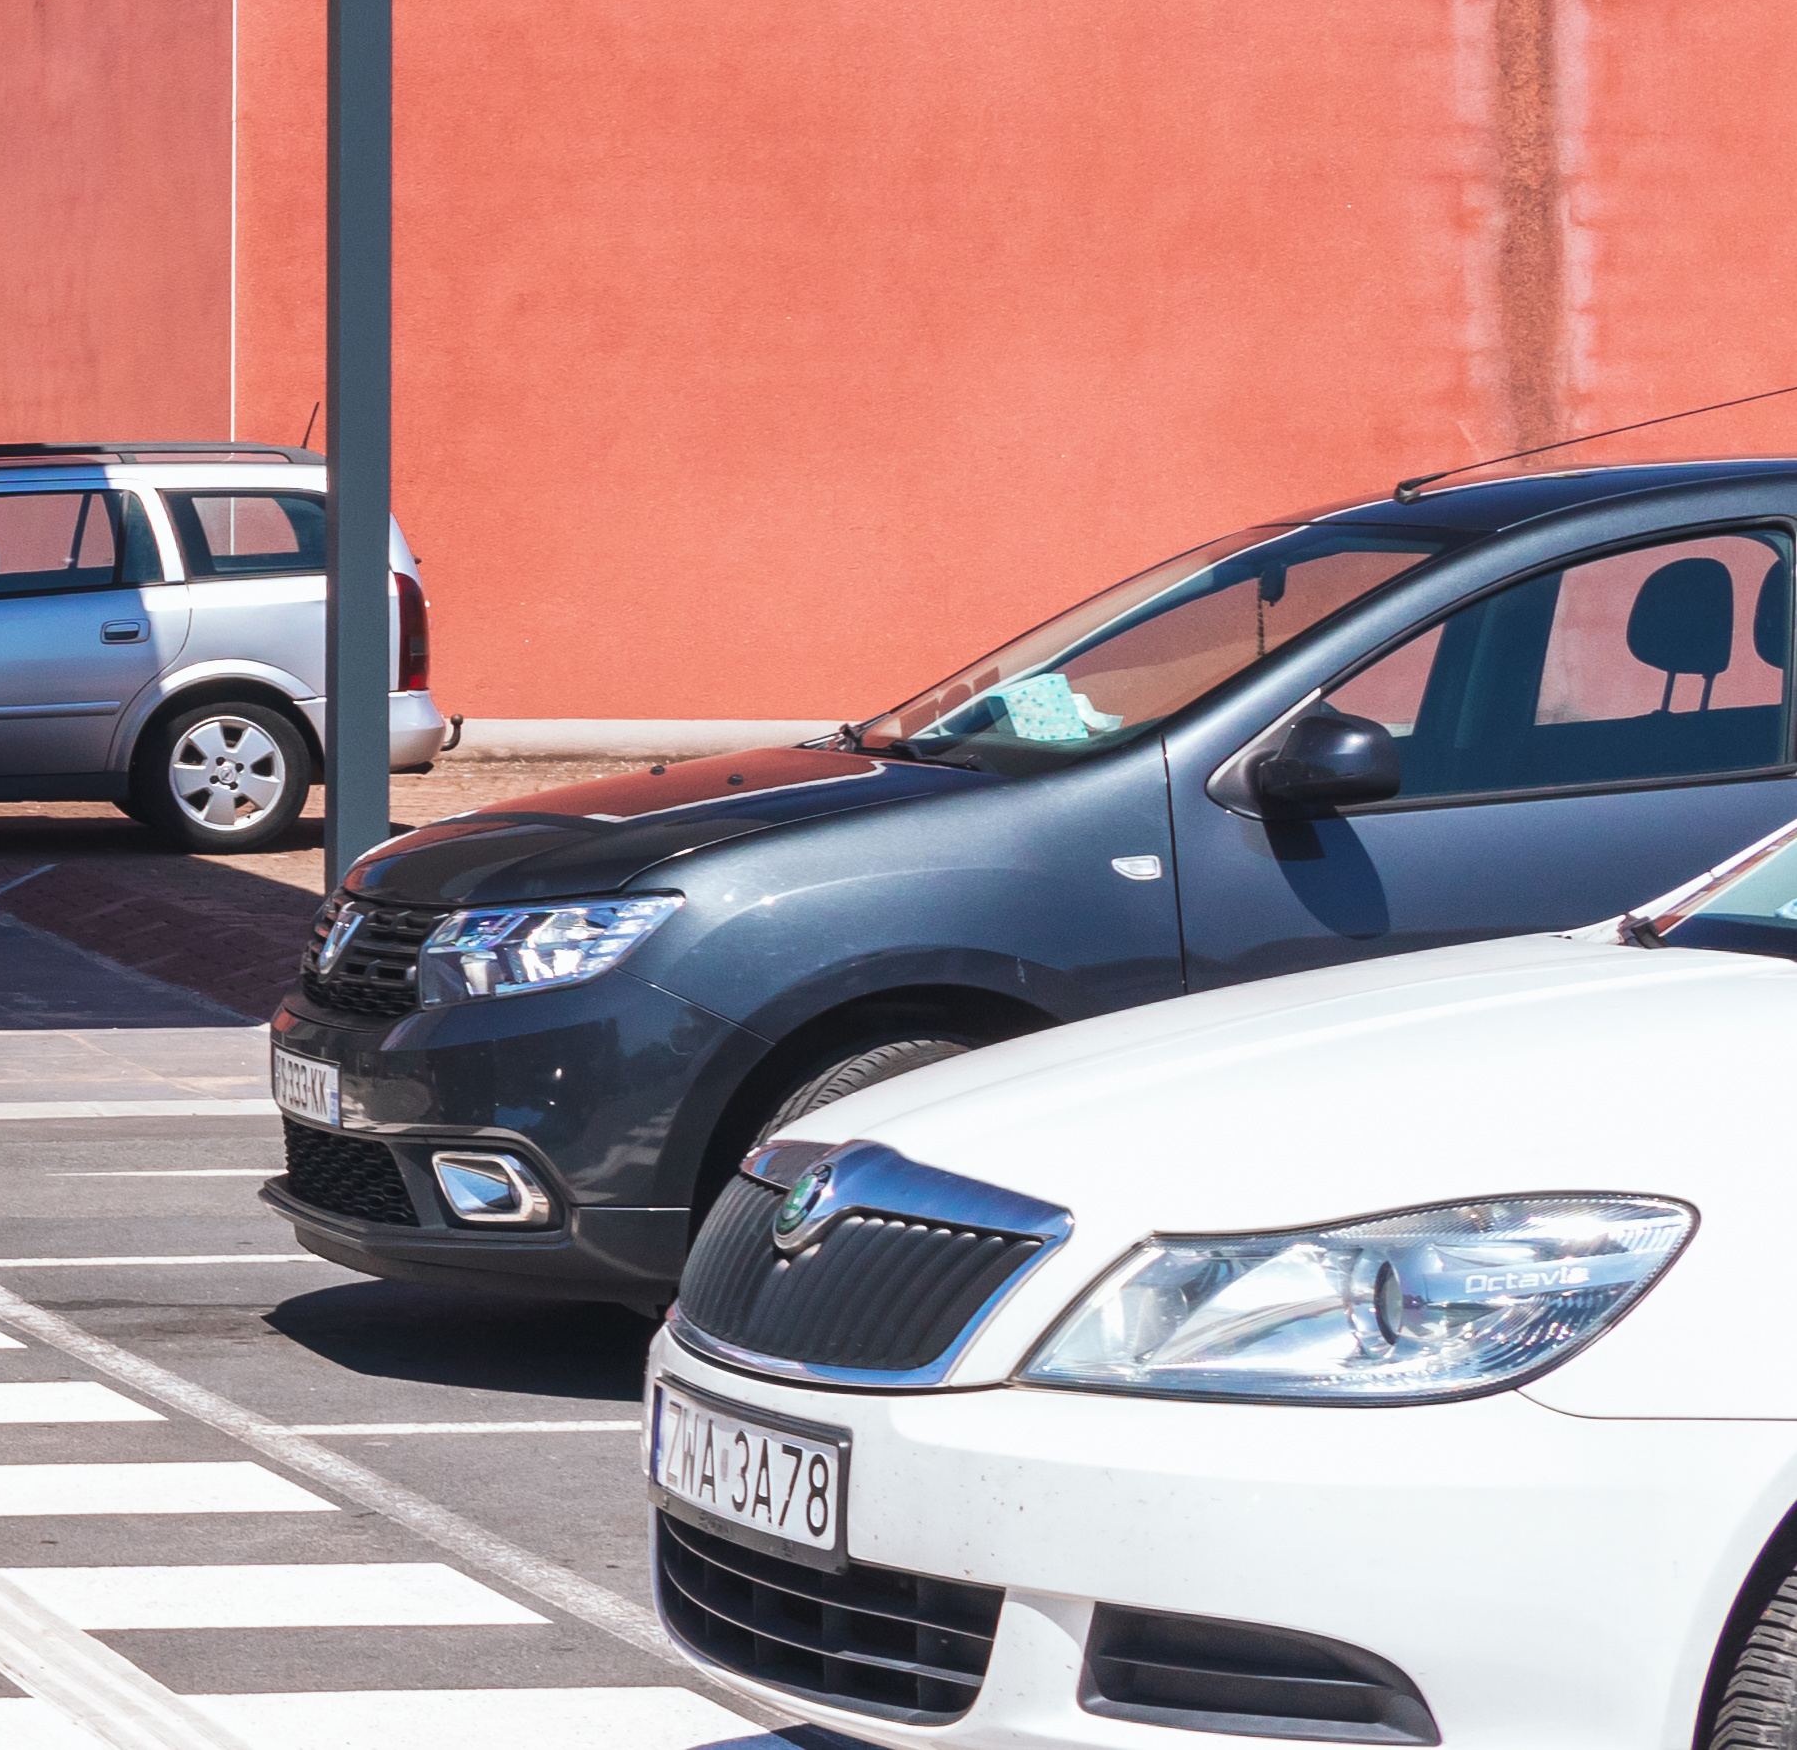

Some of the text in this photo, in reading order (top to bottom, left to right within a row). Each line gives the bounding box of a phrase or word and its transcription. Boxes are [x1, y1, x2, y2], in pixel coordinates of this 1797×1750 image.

[1464, 1265, 1591, 1294] Octavia
[665, 1400, 830, 1538] ZWA 3A78
